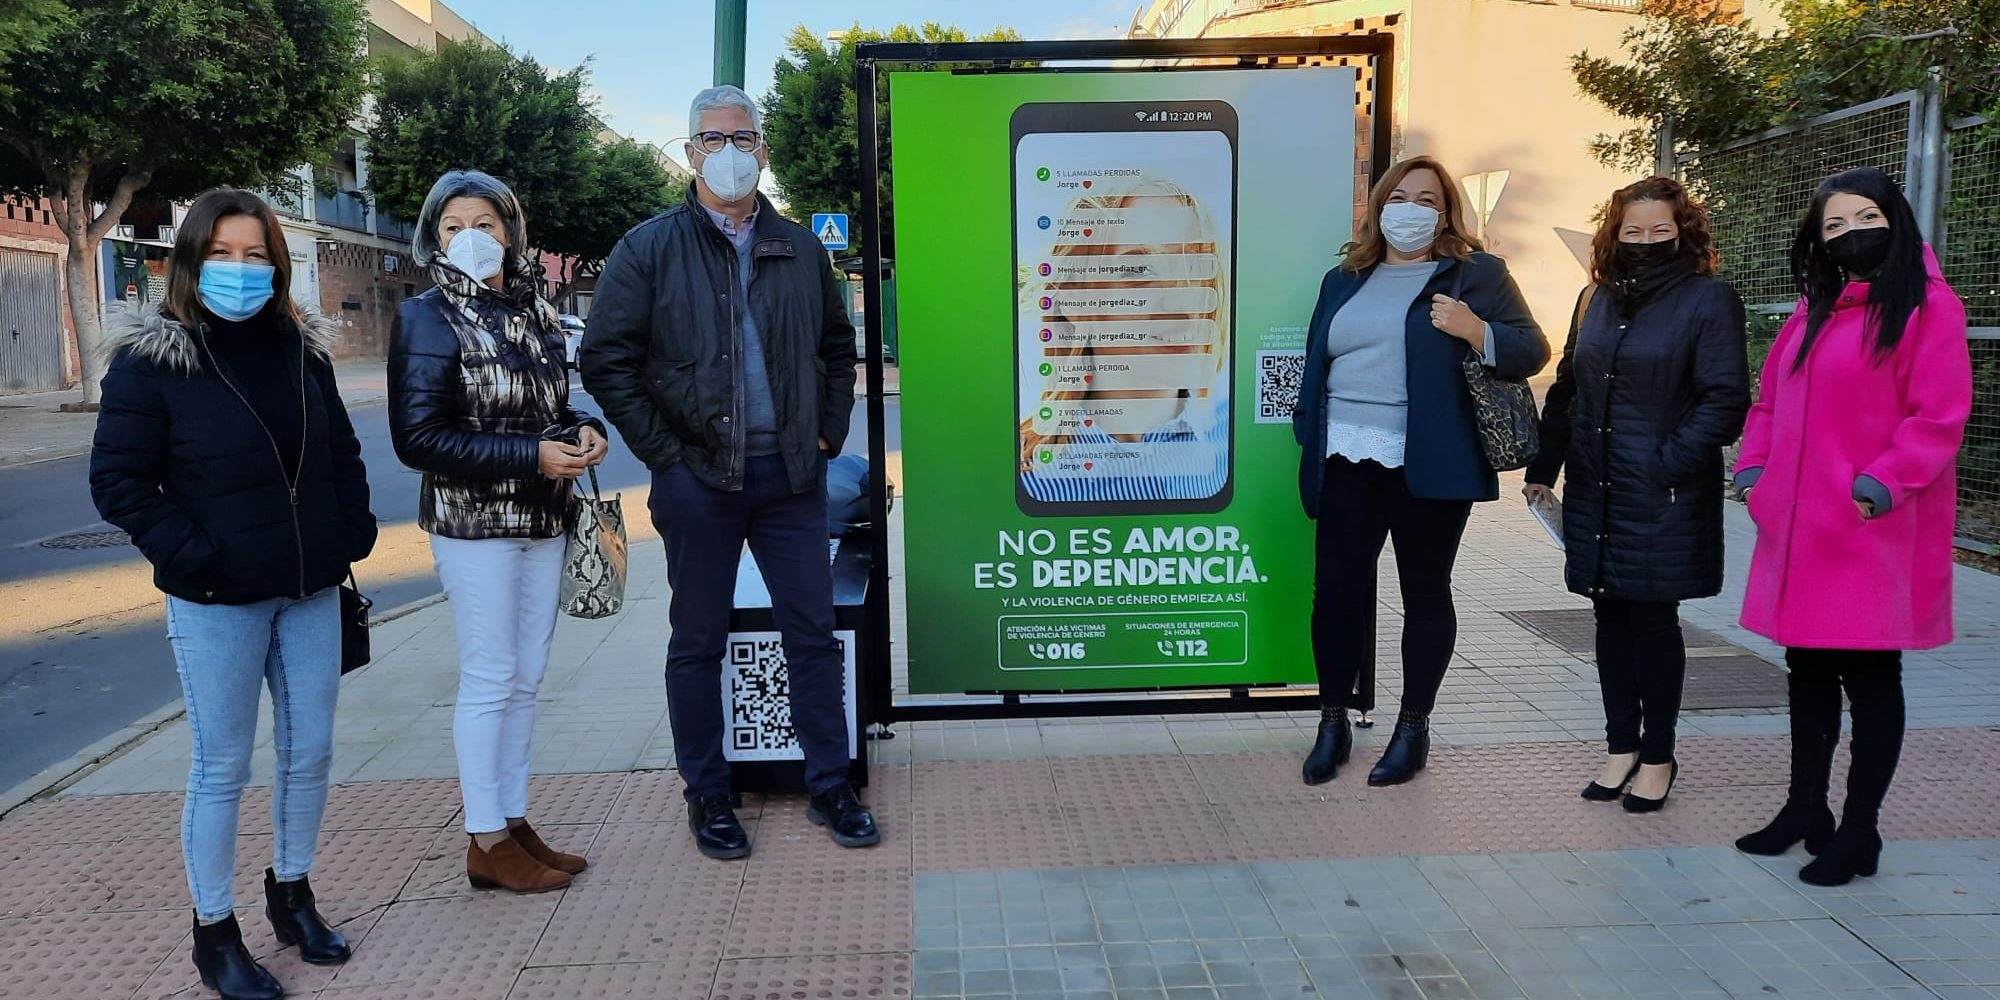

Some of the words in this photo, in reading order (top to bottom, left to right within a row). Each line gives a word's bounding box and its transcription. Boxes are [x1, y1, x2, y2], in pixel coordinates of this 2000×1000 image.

[1169, 112, 1195, 121] 12:20
[1196, 111, 1212, 121] PM
[1056, 181, 1079, 189] Jorge
[1066, 218, 1094, 227] Mensaje
[1057, 229, 1080, 238] Jorge
[1058, 266, 1086, 275] Mensaje
[1098, 265, 1147, 274] jorgediaz_gr
[1058, 300, 1086, 308] Mensaje
[1098, 299, 1147, 307] jorgediaz_gr
[1058, 333, 1086, 342] Mensaje
[1098, 332, 1147, 341] jorgediaz_gr
[1058, 375, 1080, 383] Jorge
[1058, 419, 1080, 427] Jorge
[1058, 463, 1080, 471] Jorge
[999, 529, 1056, 556] NO
[1069, 528, 1112, 555] ES
[1122, 526, 1250, 555] AMOR,
[974, 562, 1018, 589] ES
[1032, 556, 1268, 588] DEPENDENCIA.
[1001, 598, 1009, 608] Y
[1012, 598, 1028, 607] LA
[1030, 596, 1096, 607] VIOLENCIA
[1098, 596, 1114, 605] DE
[1117, 594, 1168, 605] GÉNERO
[1170, 594, 1224, 604] EMPIEZA
[1226, 592, 1249, 603] ASÍ.
[1006, 624, 1046, 633] ATENCIÓN
[1125, 622, 1175, 630] SITUACIONES
[1007, 632, 1018, 640] DE
[1046, 642, 1086, 660] 016
[1176, 639, 1208, 657] 112
